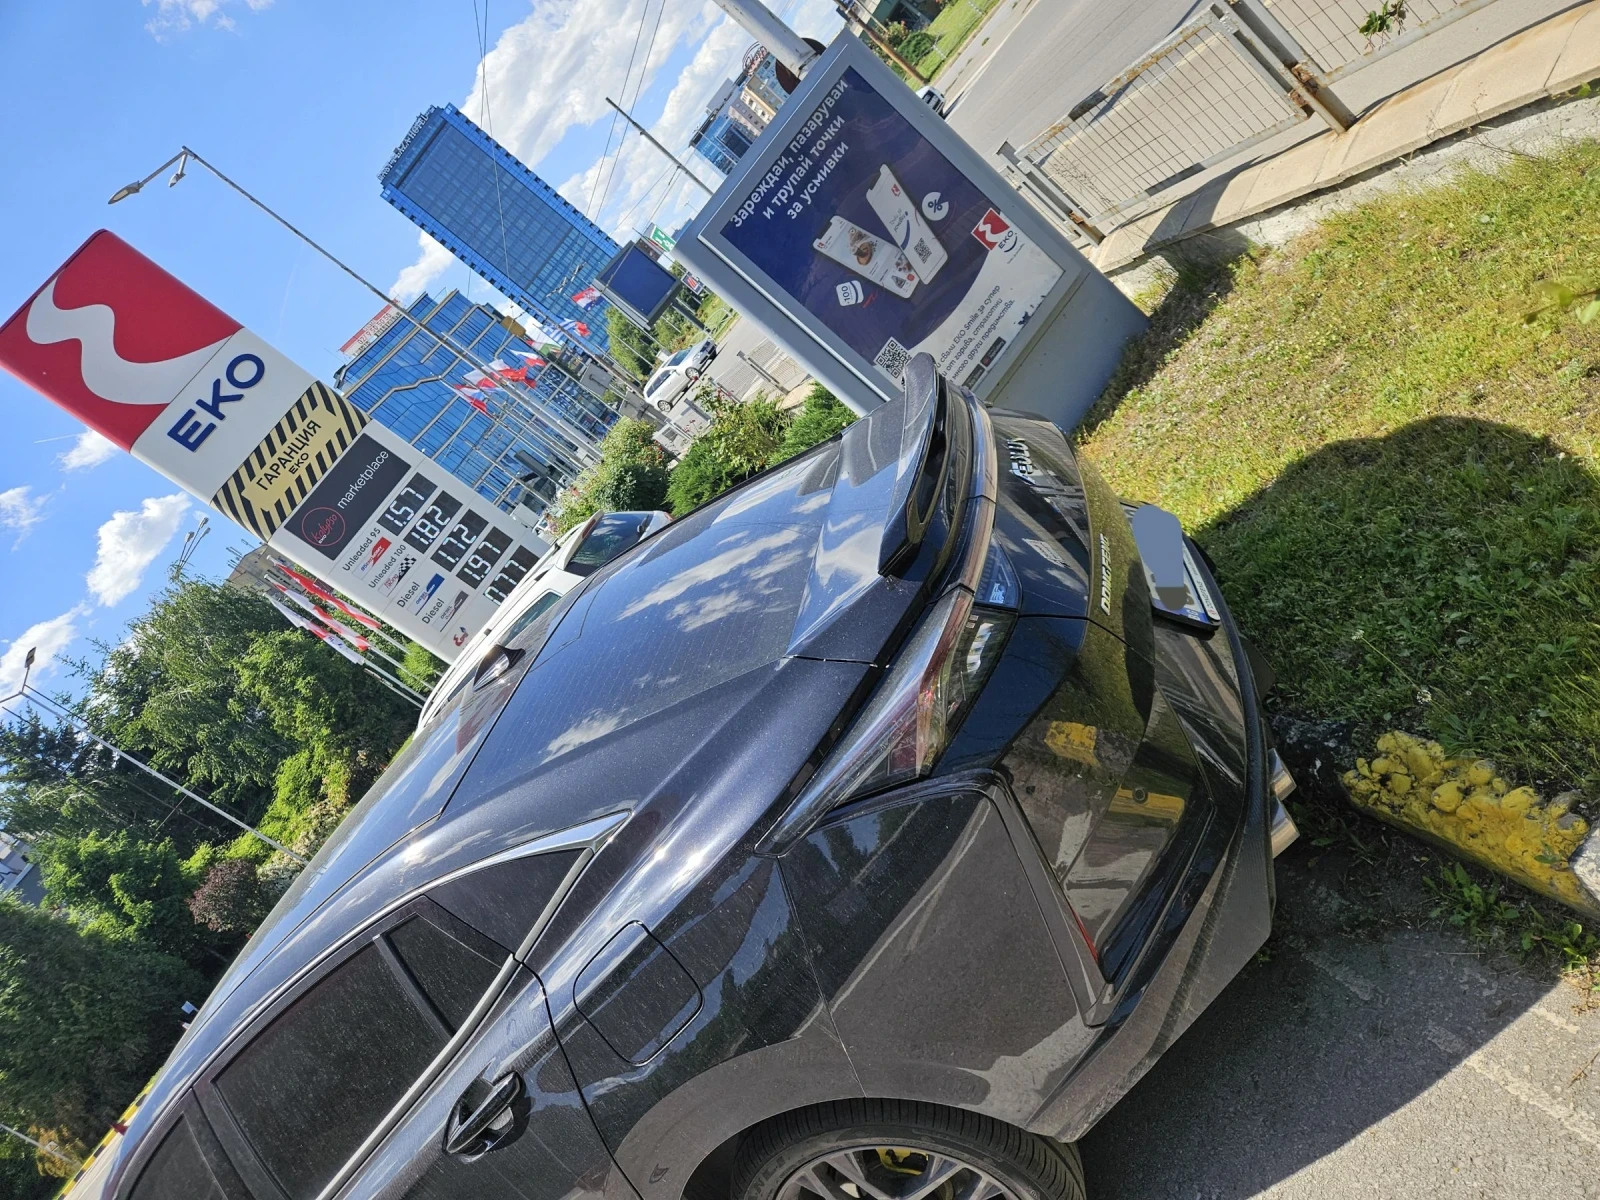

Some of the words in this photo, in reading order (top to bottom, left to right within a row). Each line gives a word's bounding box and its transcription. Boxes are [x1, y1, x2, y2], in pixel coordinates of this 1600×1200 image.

[761, 206, 774, 219] и
[770, 154, 813, 206] трупай
[809, 115, 846, 157] точки
[786, 200, 804, 220] за
[798, 141, 849, 204] усмивки
[997, 229, 1015, 249] EKO
[938, 342, 956, 363] свали
[952, 328, 967, 344] EKO
[963, 311, 979, 330] Smile
[977, 304, 986, 315] за
[983, 283, 1001, 305] супер
[945, 357, 956, 371] от
[971, 297, 1003, 336] страхотни
[950, 357, 969, 379] много
[966, 339, 983, 361] други
[980, 297, 1015, 341] предимства.
[165, 350, 263, 454] EKO
[255, 419, 321, 490] ГАРАНЦИЯ
[288, 450, 310, 474] EKO
[336, 449, 389, 508] marketplace
[383, 485, 425, 527] 1.57
[410, 503, 451, 546] 1.82
[341, 536, 373, 571] Unleaded
[369, 526, 381, 538] 95
[437, 522, 477, 563] 1.72
[463, 539, 501, 581] 1.97
[367, 554, 398, 589] Unleaded
[394, 543, 407, 556] 100
[1100, 532, 1111, 615] DONGFENG
[396, 580, 420, 607] Diesel
[421, 597, 445, 624] Diesel
